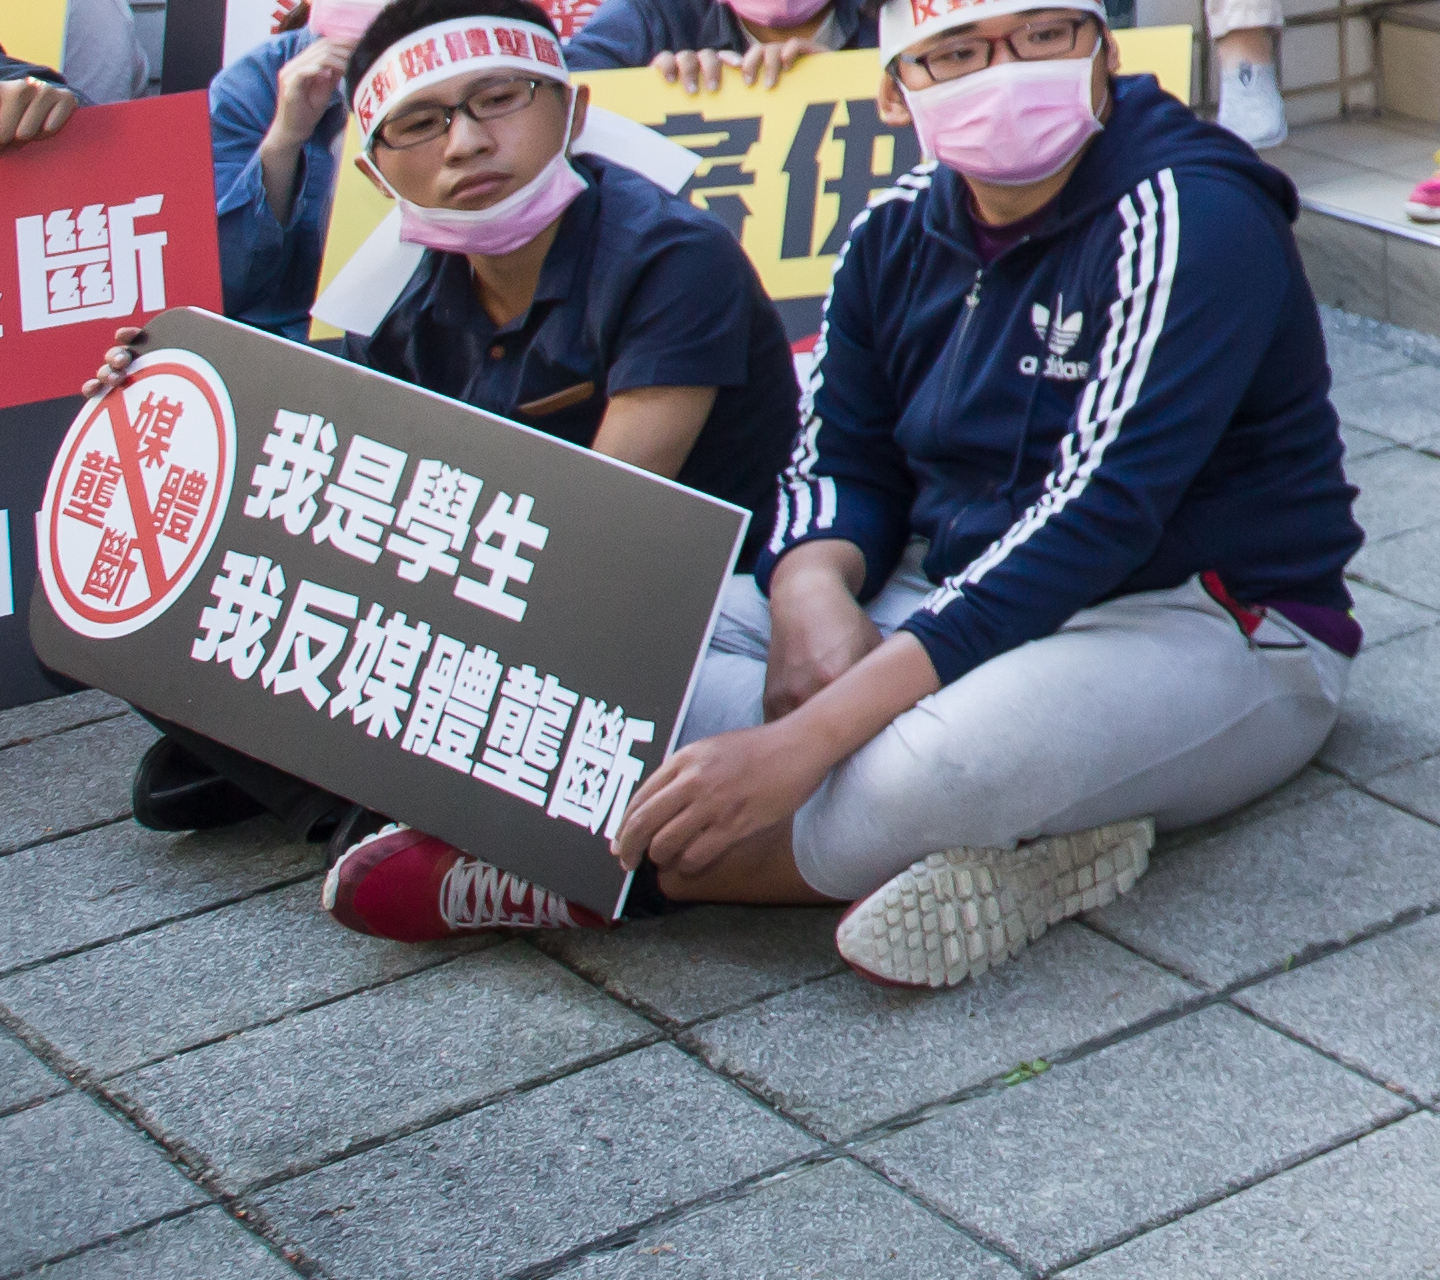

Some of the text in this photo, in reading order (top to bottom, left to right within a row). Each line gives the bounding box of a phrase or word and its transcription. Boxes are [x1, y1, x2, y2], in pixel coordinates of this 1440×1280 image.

[0, 194, 167, 337] 斷
[243, 409, 549, 622] 我是學生
[192, 551, 655, 840] 我反媒體壟斷
